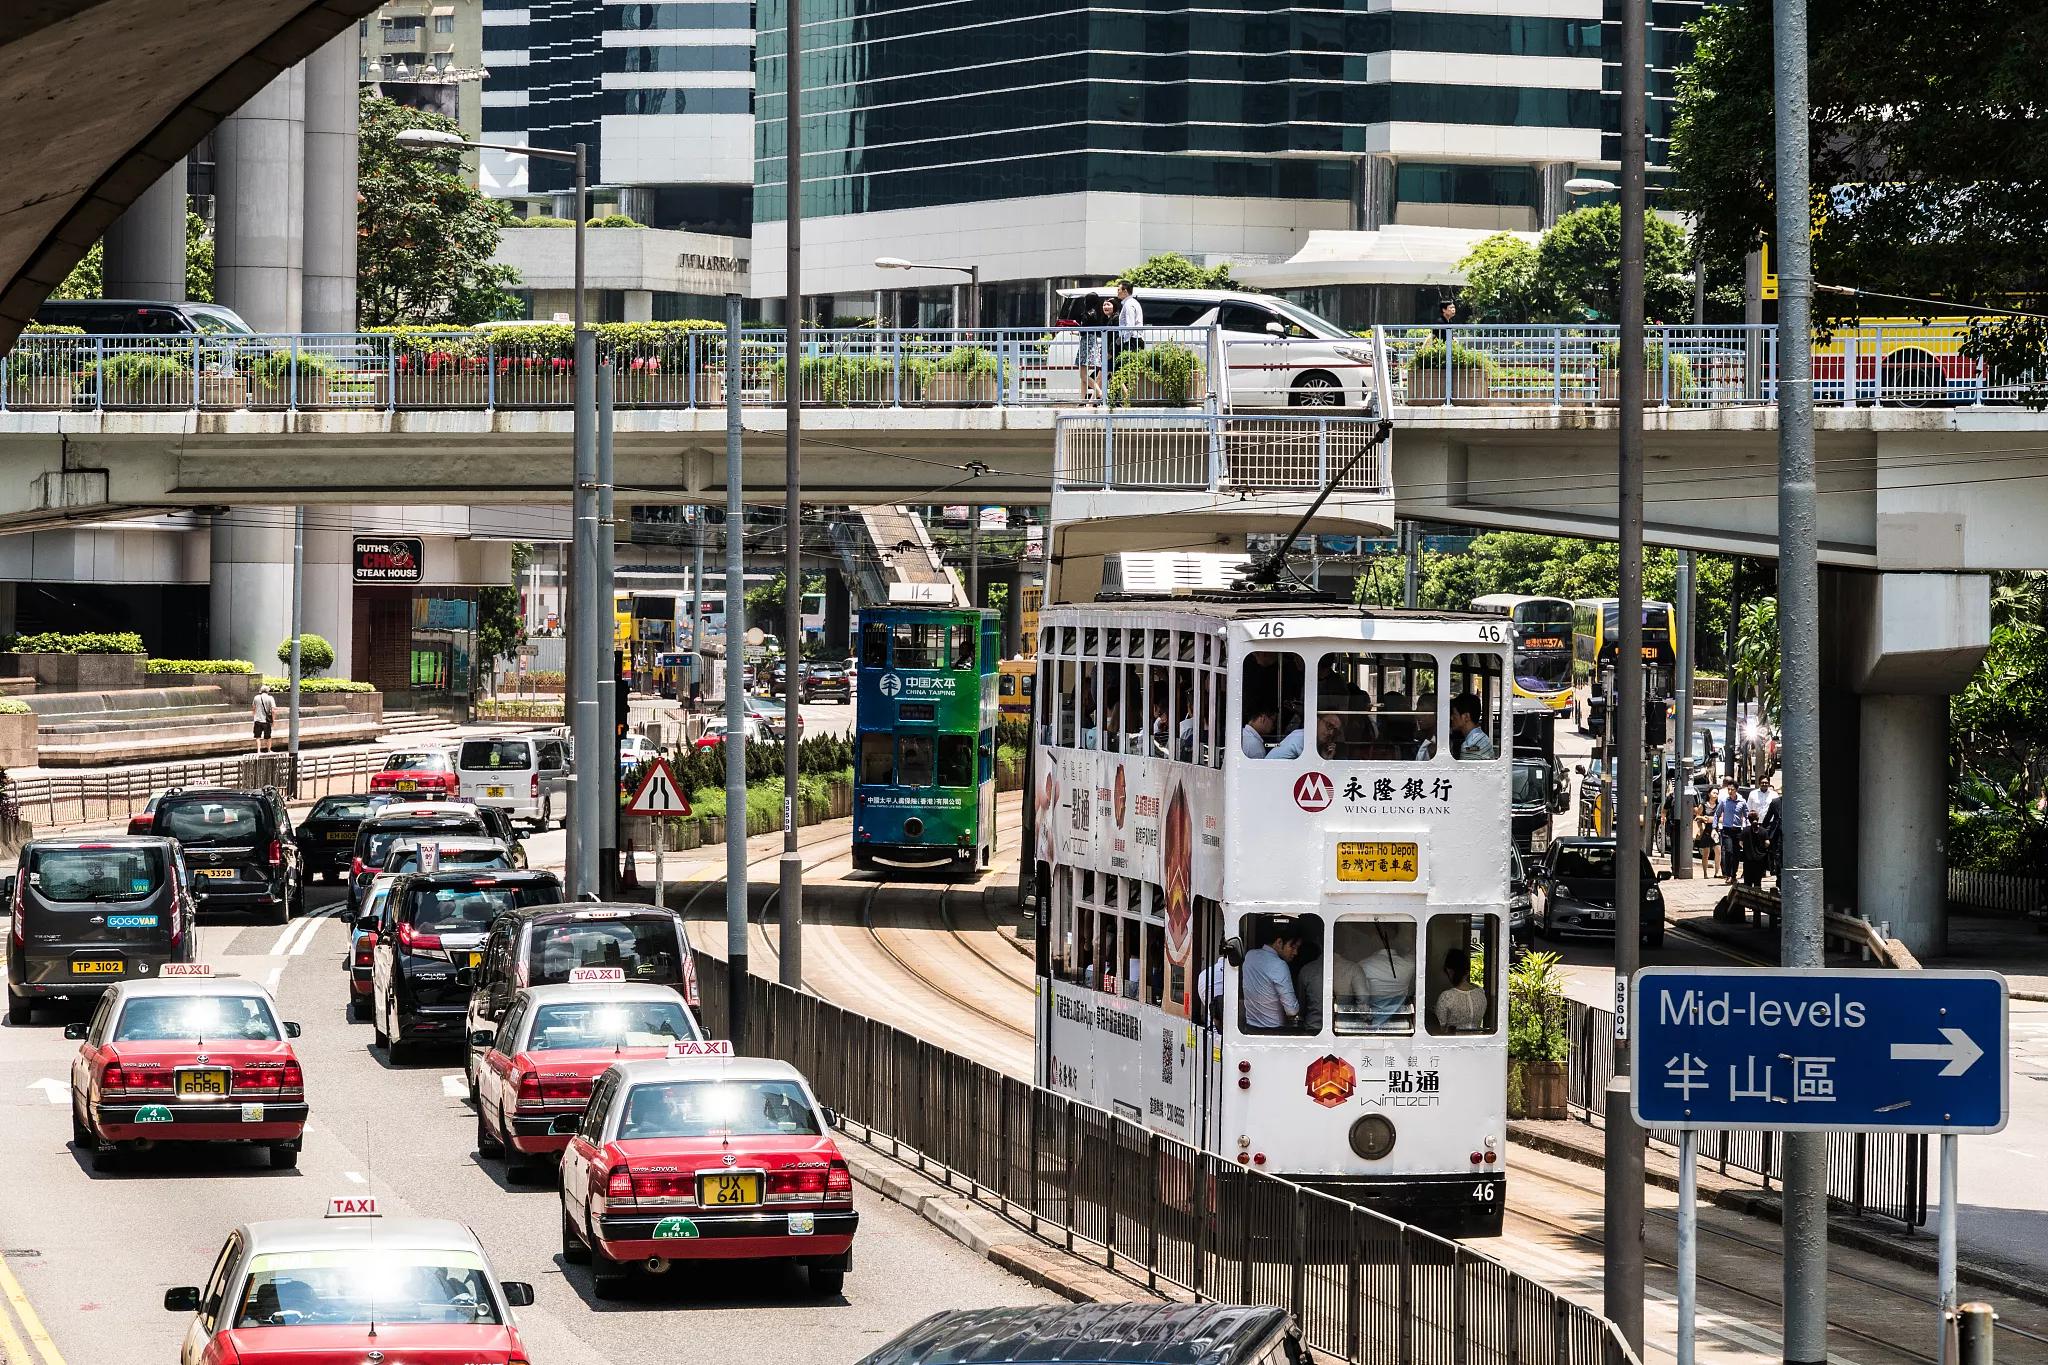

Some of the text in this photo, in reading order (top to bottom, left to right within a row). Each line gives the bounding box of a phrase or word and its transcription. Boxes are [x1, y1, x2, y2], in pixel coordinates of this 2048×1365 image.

[696, 254, 750, 274] MARRIOTT
[356, 544, 389, 553] RUTH'S
[356, 568, 418, 578] STEAK HOUSE
[911, 585, 933, 600] 114
[1258, 621, 1285, 638] 46
[1477, 625, 1501, 643] 46
[905, 676, 956, 689] 中国太平
[928, 689, 956, 697] TAIPING
[1342, 776, 1453, 802] 永隆銀行
[1344, 805, 1451, 815] WING LUNG BANK
[957, 848, 970, 858] 114
[1341, 843, 1415, 858] Sai Wan Ho Depot
[133, 884, 148, 892] VAN
[109, 917, 156, 926] GOGOVAN
[76, 962, 120, 972] TP 3102
[164, 964, 210, 975] TAXI
[574, 969, 621, 980] TAXI
[1616, 982, 1625, 1036] 35604
[1660, 989, 1866, 1029] Mid-levels
[674, 1041, 729, 1055] TAXI
[1362, 1055, 1441, 1068] 永隆銀行
[193, 1072, 212, 1083] PC
[1361, 1070, 1440, 1093] 一點通
[1663, 1052, 1837, 1103] 半山區
[184, 1082, 221, 1093] 6088
[150, 1109, 158, 1117] 4
[718, 1175, 742, 1190] UX
[716, 1189, 745, 1203] 641
[1472, 1183, 1495, 1201] 46
[333, 1199, 376, 1213] TAXI
[671, 1222, 681, 1232] 4
